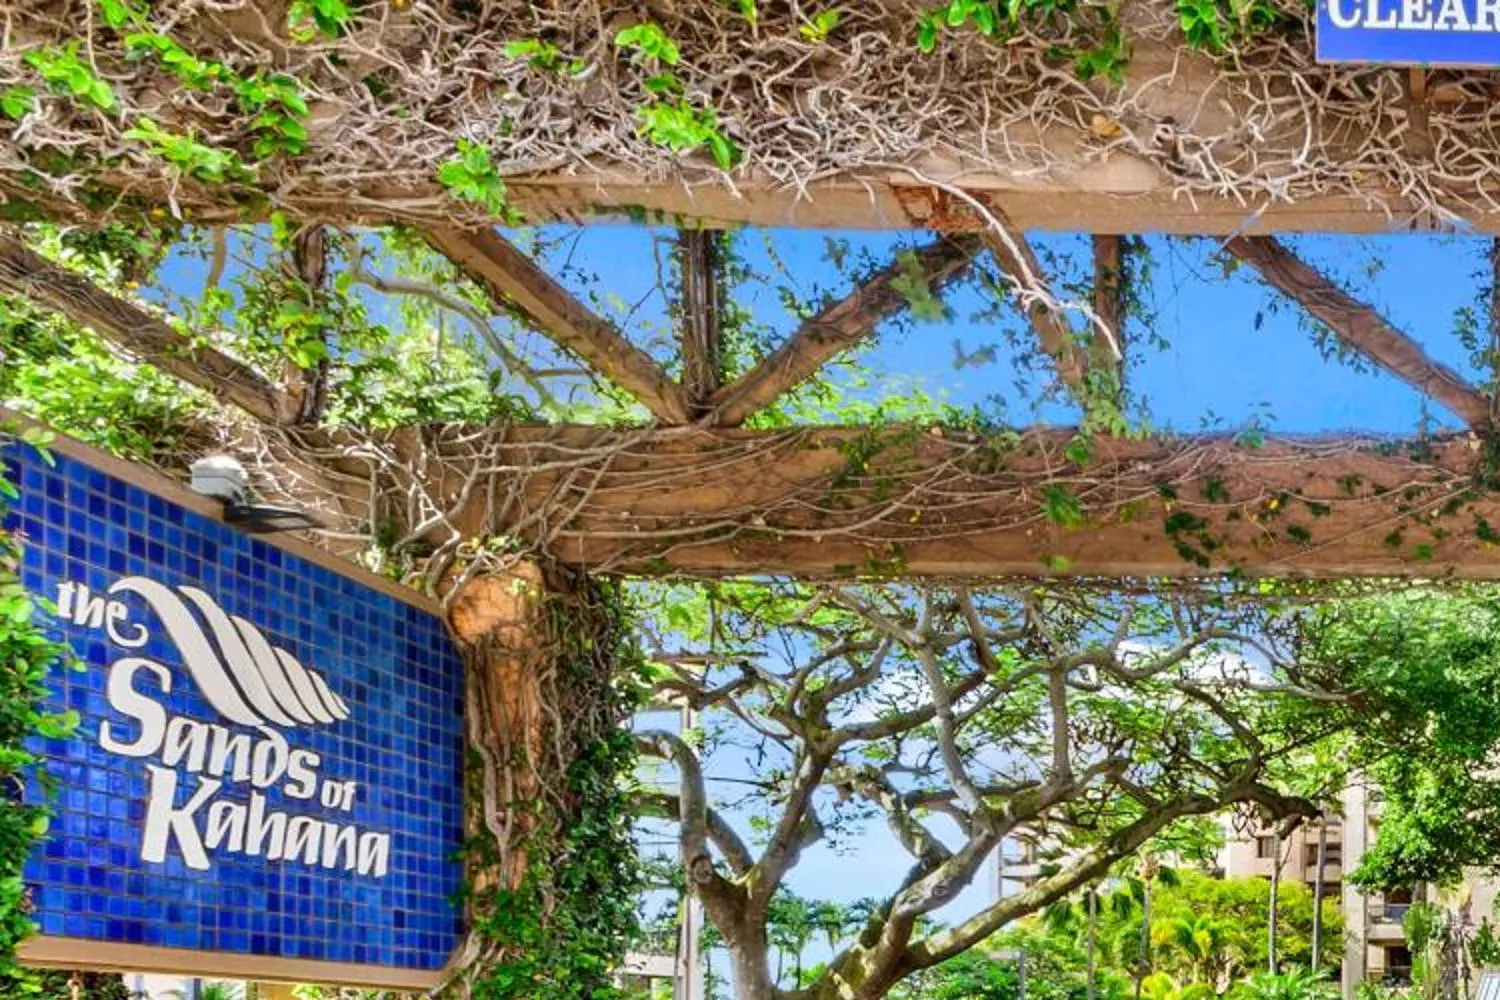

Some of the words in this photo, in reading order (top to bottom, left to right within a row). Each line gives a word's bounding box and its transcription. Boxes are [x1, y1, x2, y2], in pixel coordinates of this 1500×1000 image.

[57, 582, 149, 648] the
[100, 657, 321, 800] Sands
[321, 781, 357, 812] of
[140, 763, 390, 879] Kahana
